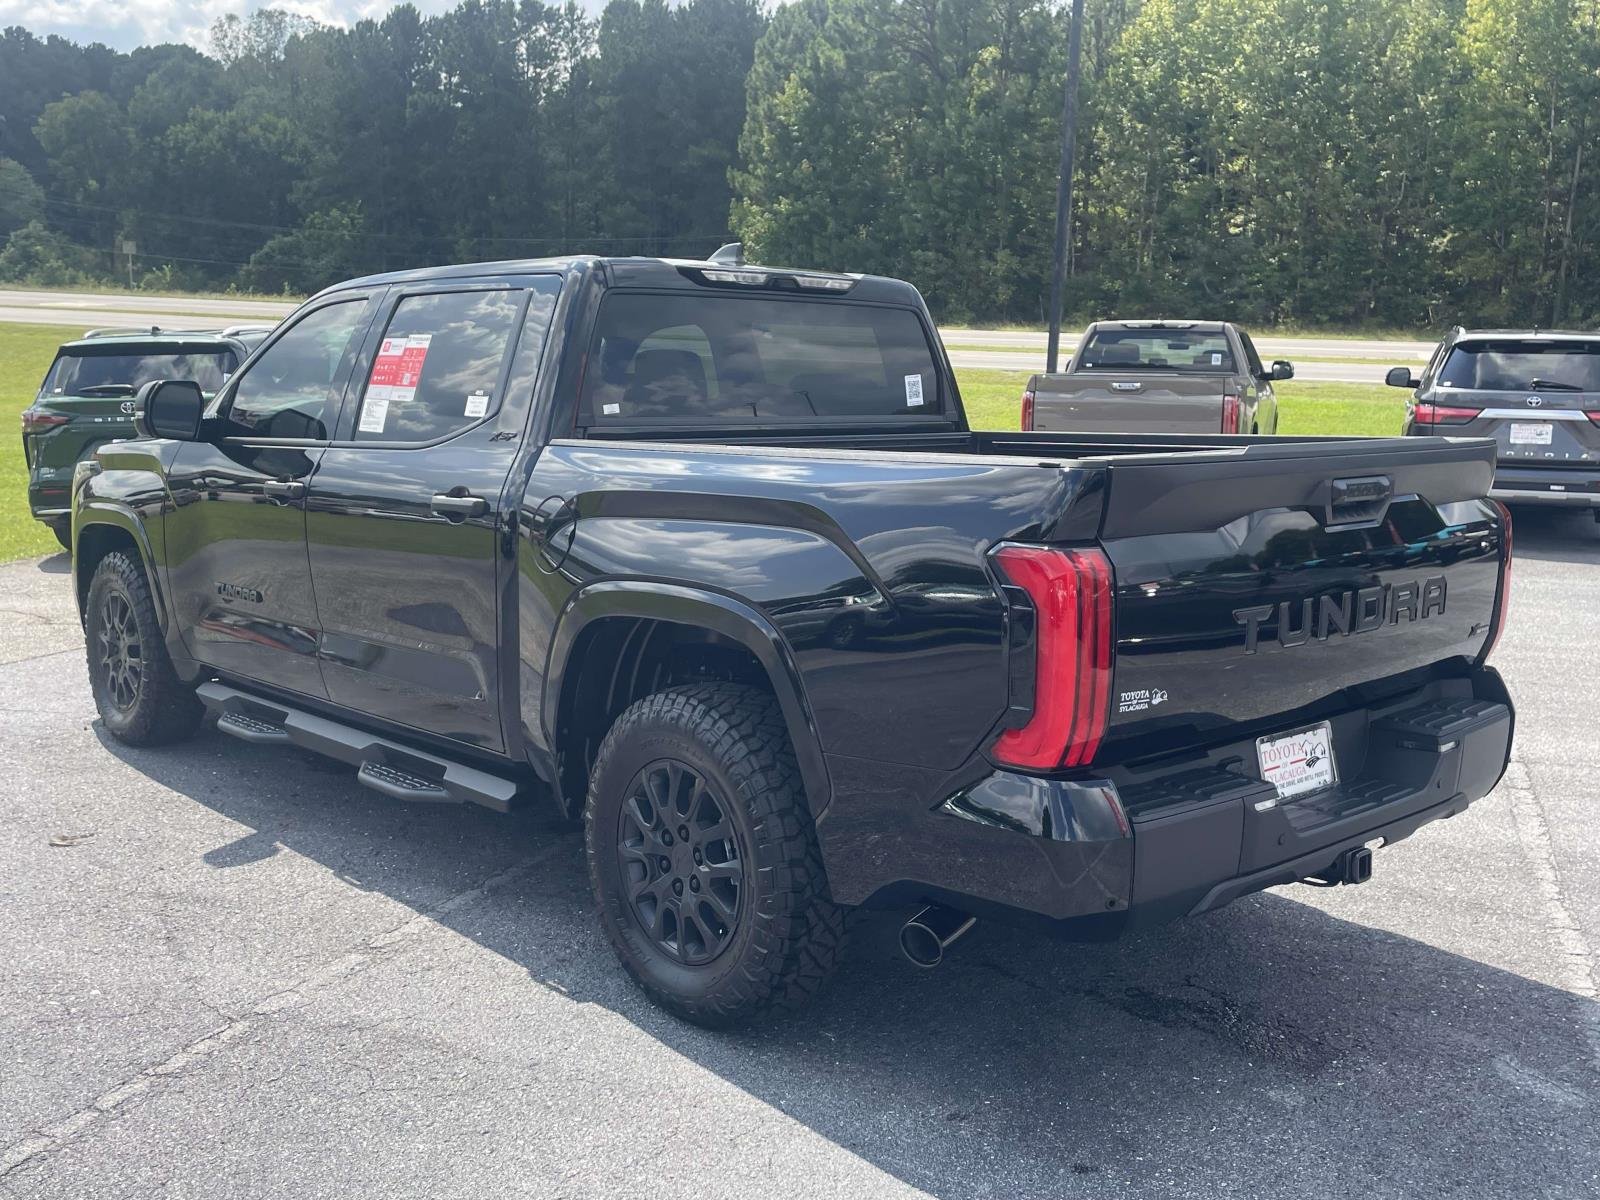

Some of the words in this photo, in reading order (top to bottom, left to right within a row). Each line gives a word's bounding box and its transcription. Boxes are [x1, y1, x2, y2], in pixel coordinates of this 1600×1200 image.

[214, 581, 257, 602] TUNDRA
[1232, 575, 1447, 655] TUNDRA
[1120, 690, 1149, 701] TOYOTA
[1262, 742, 1305, 764] TOYOTA
